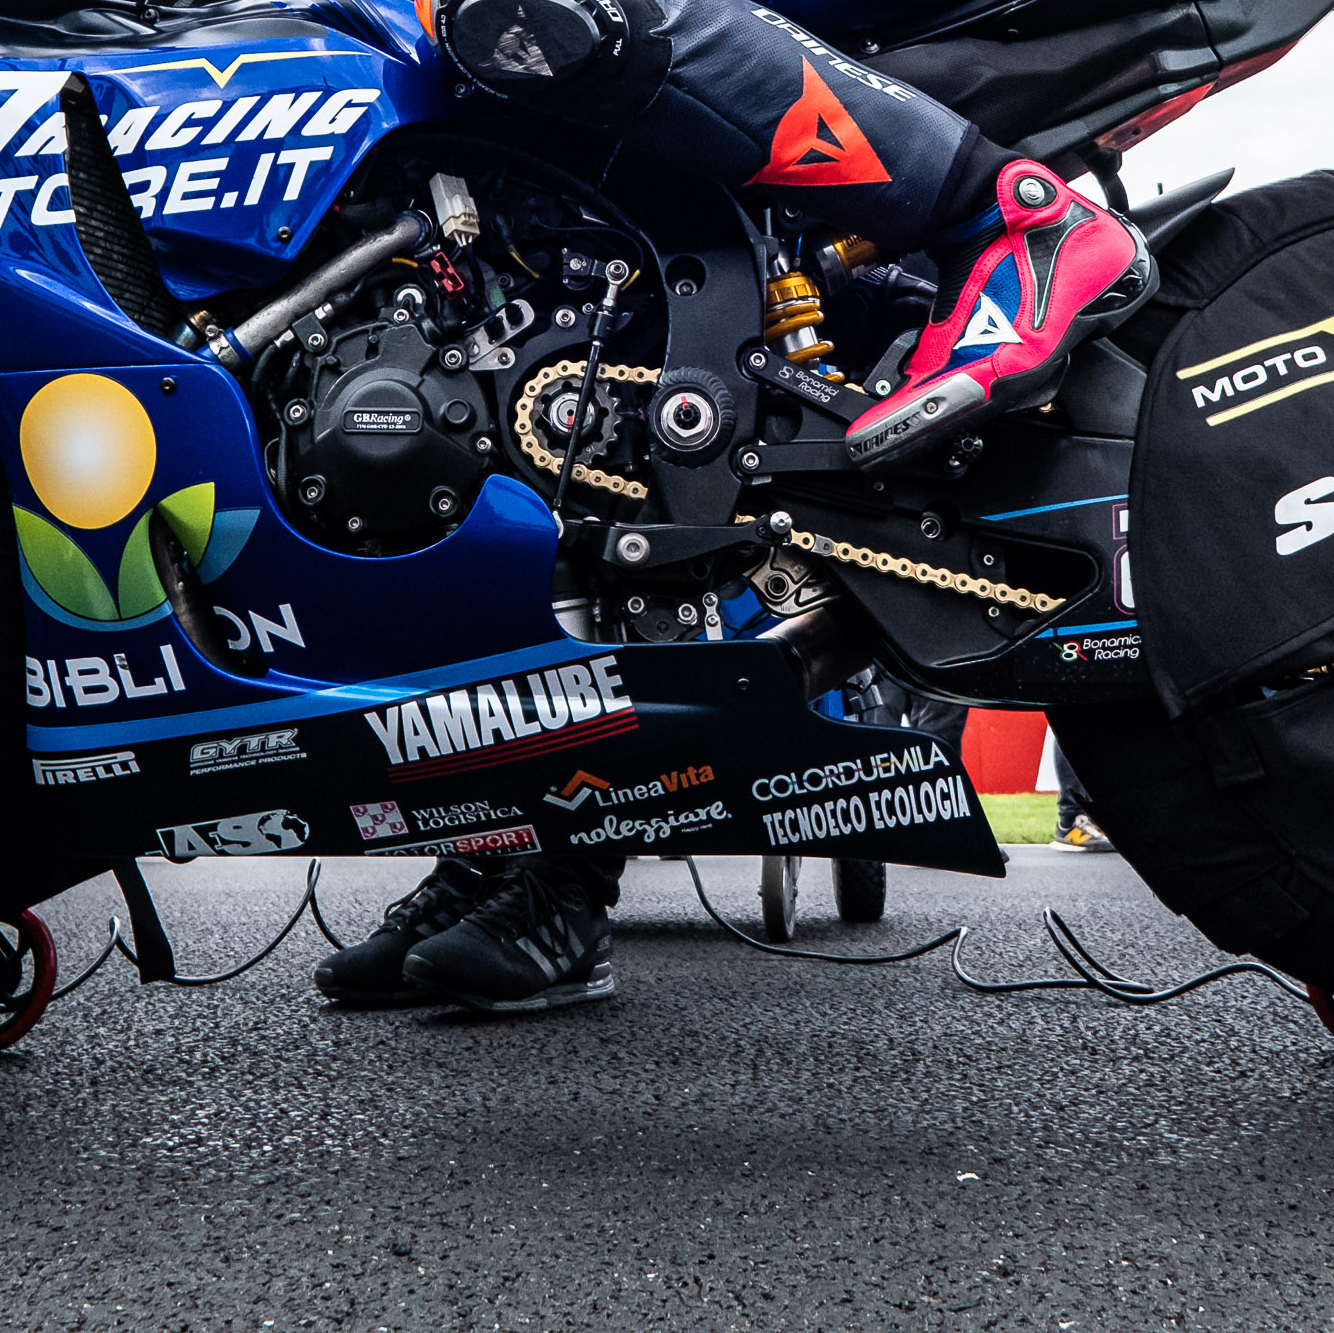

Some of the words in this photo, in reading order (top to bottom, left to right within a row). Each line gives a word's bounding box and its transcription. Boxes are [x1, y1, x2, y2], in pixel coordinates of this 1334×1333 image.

[750, 6, 918, 103] DAINESE
[1082, 633, 1143, 650] Bonamic
[1093, 647, 1141, 661] Racing
[363, 654, 633, 765] YAMALUBE
[189, 727, 299, 763] GYTR
[31, 751, 141, 786] PIRELLI
[189, 759, 257, 776] PERFORMANCE
[258, 751, 308, 765] PRODUCTS
[751, 741, 951, 803] COLORDUEMILA
[411, 800, 491, 822] WILSON
[416, 805, 524, 832] LOGISTICA
[762, 794, 867, 847] TECNOECO
[869, 774, 972, 830] ECOLOGIA
